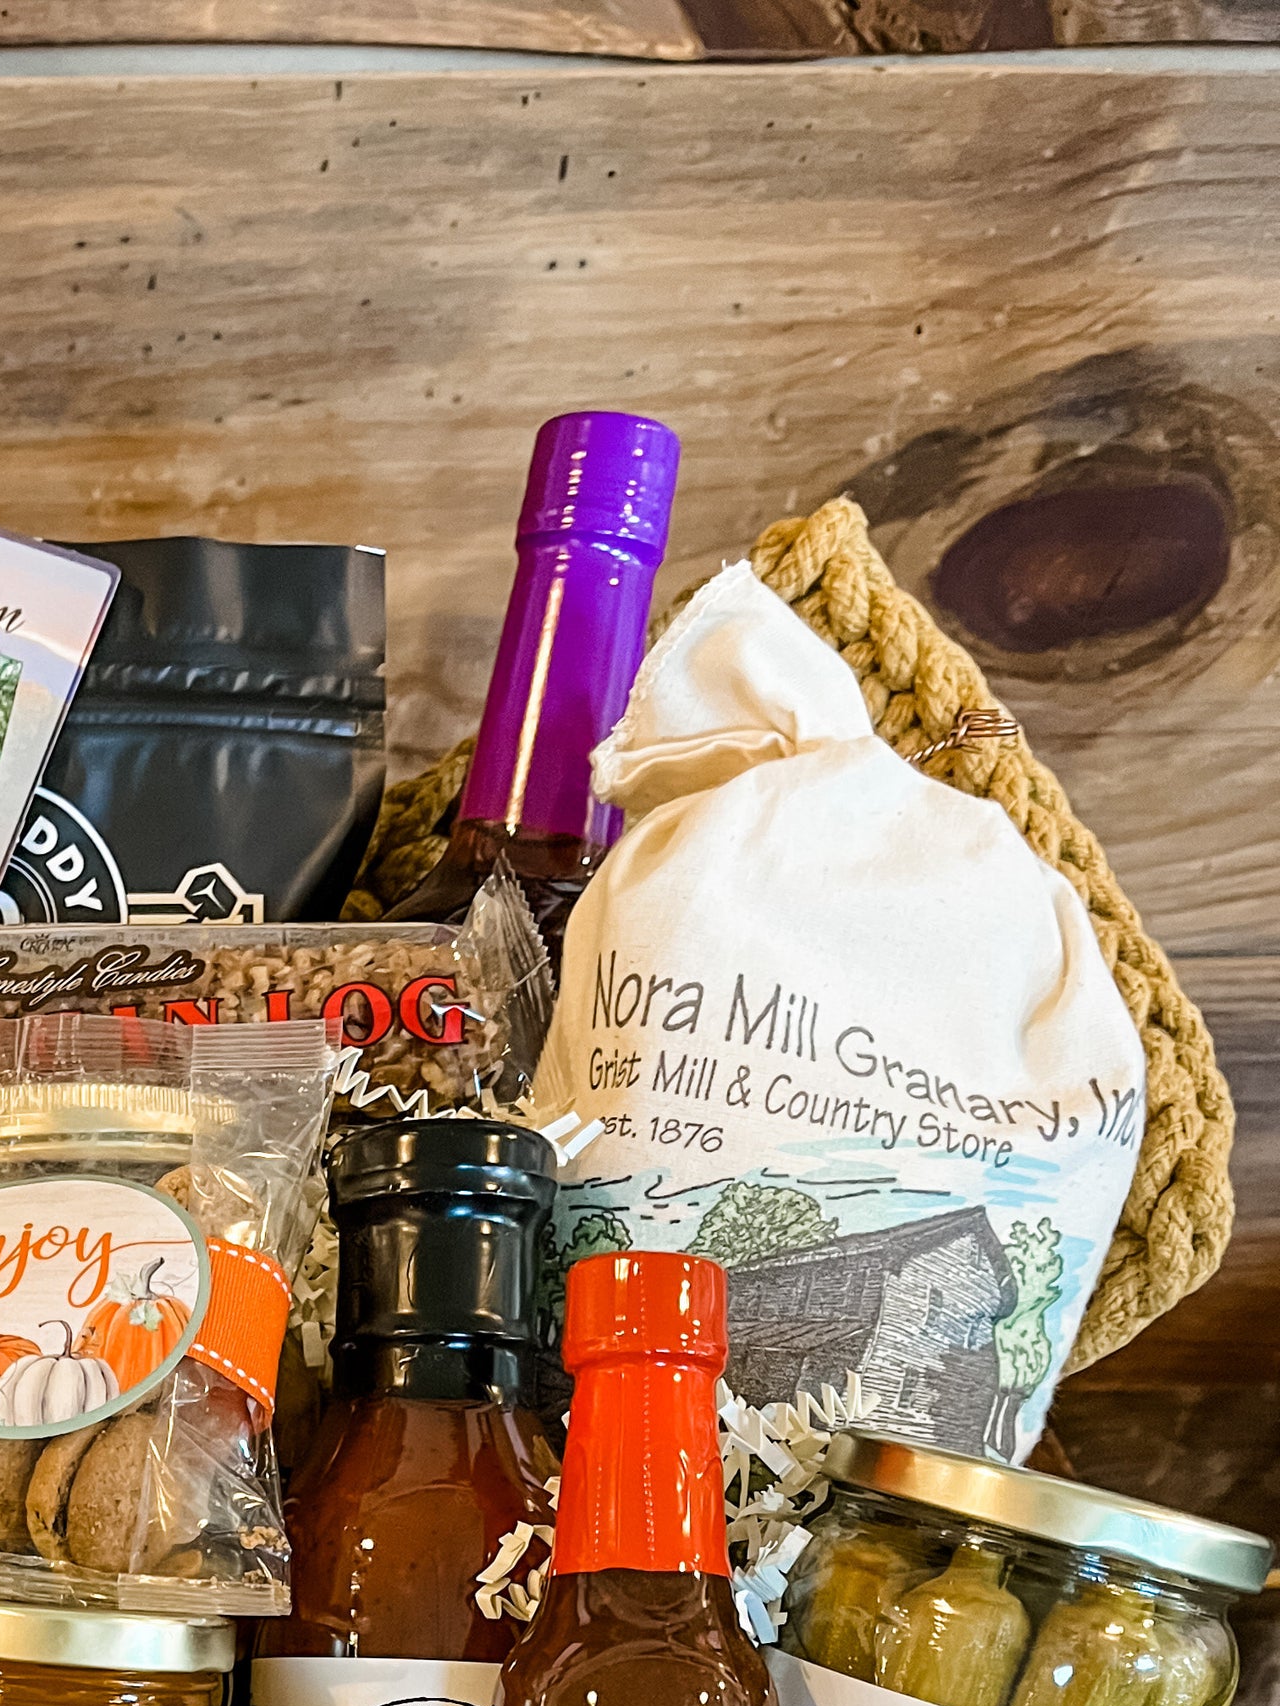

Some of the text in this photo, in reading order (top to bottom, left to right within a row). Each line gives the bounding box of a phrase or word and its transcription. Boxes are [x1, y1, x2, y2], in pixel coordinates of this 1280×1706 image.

[91, 950, 199, 989] Candies
[590, 950, 704, 1032] Nora
[725, 972, 819, 1062] Mill
[835, 1025, 1080, 1141] Granary,
[589, 1047, 1014, 1169] Grist Mill & Country Store
[650, 1116, 724, 1153] 1876
